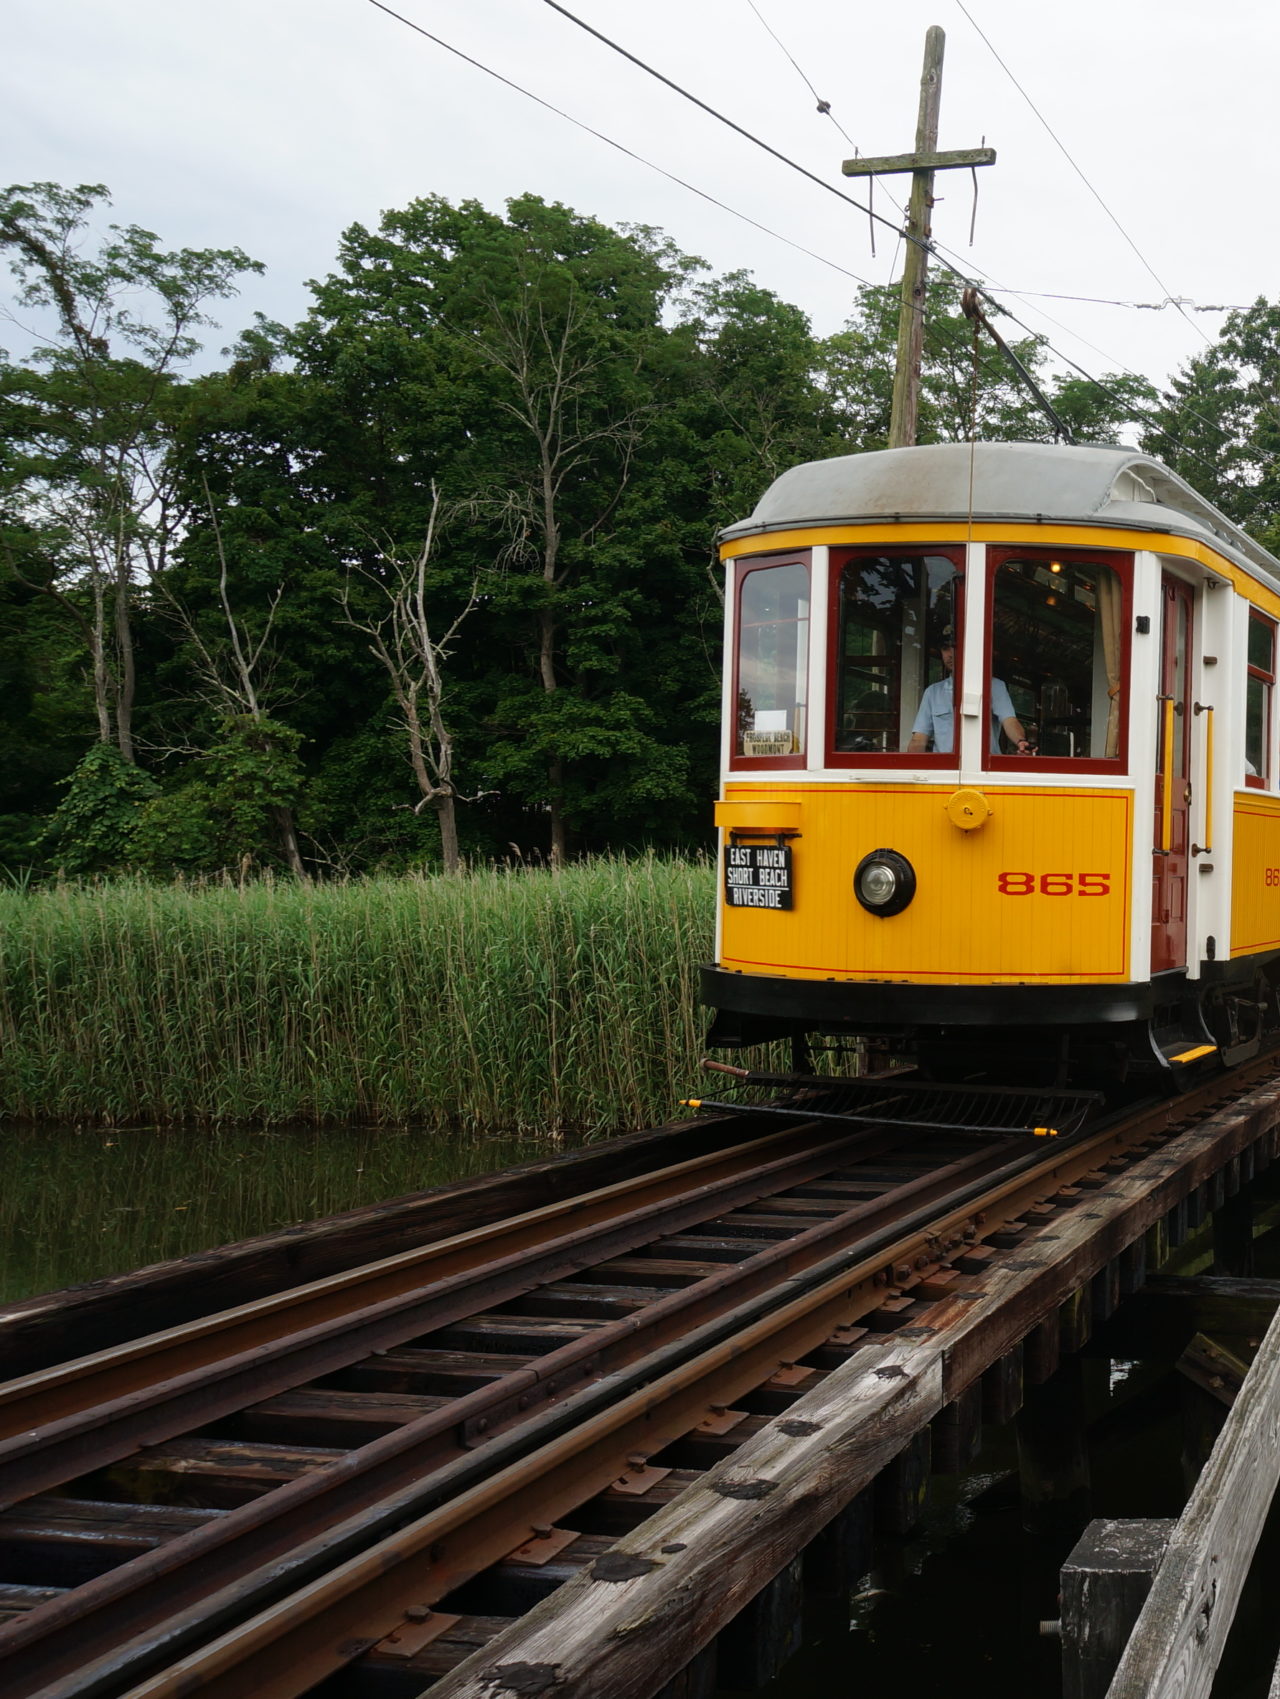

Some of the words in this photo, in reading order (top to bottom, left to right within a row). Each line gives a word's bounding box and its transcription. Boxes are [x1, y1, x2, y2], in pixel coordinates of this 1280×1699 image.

[730, 848, 751, 866] EAST
[756, 849, 786, 868] HAVEN
[727, 867, 754, 885] SHORT
[759, 868, 788, 887] BEACH
[998, 872, 1110, 896] 865
[733, 887, 782, 908] RIVERSIDE
